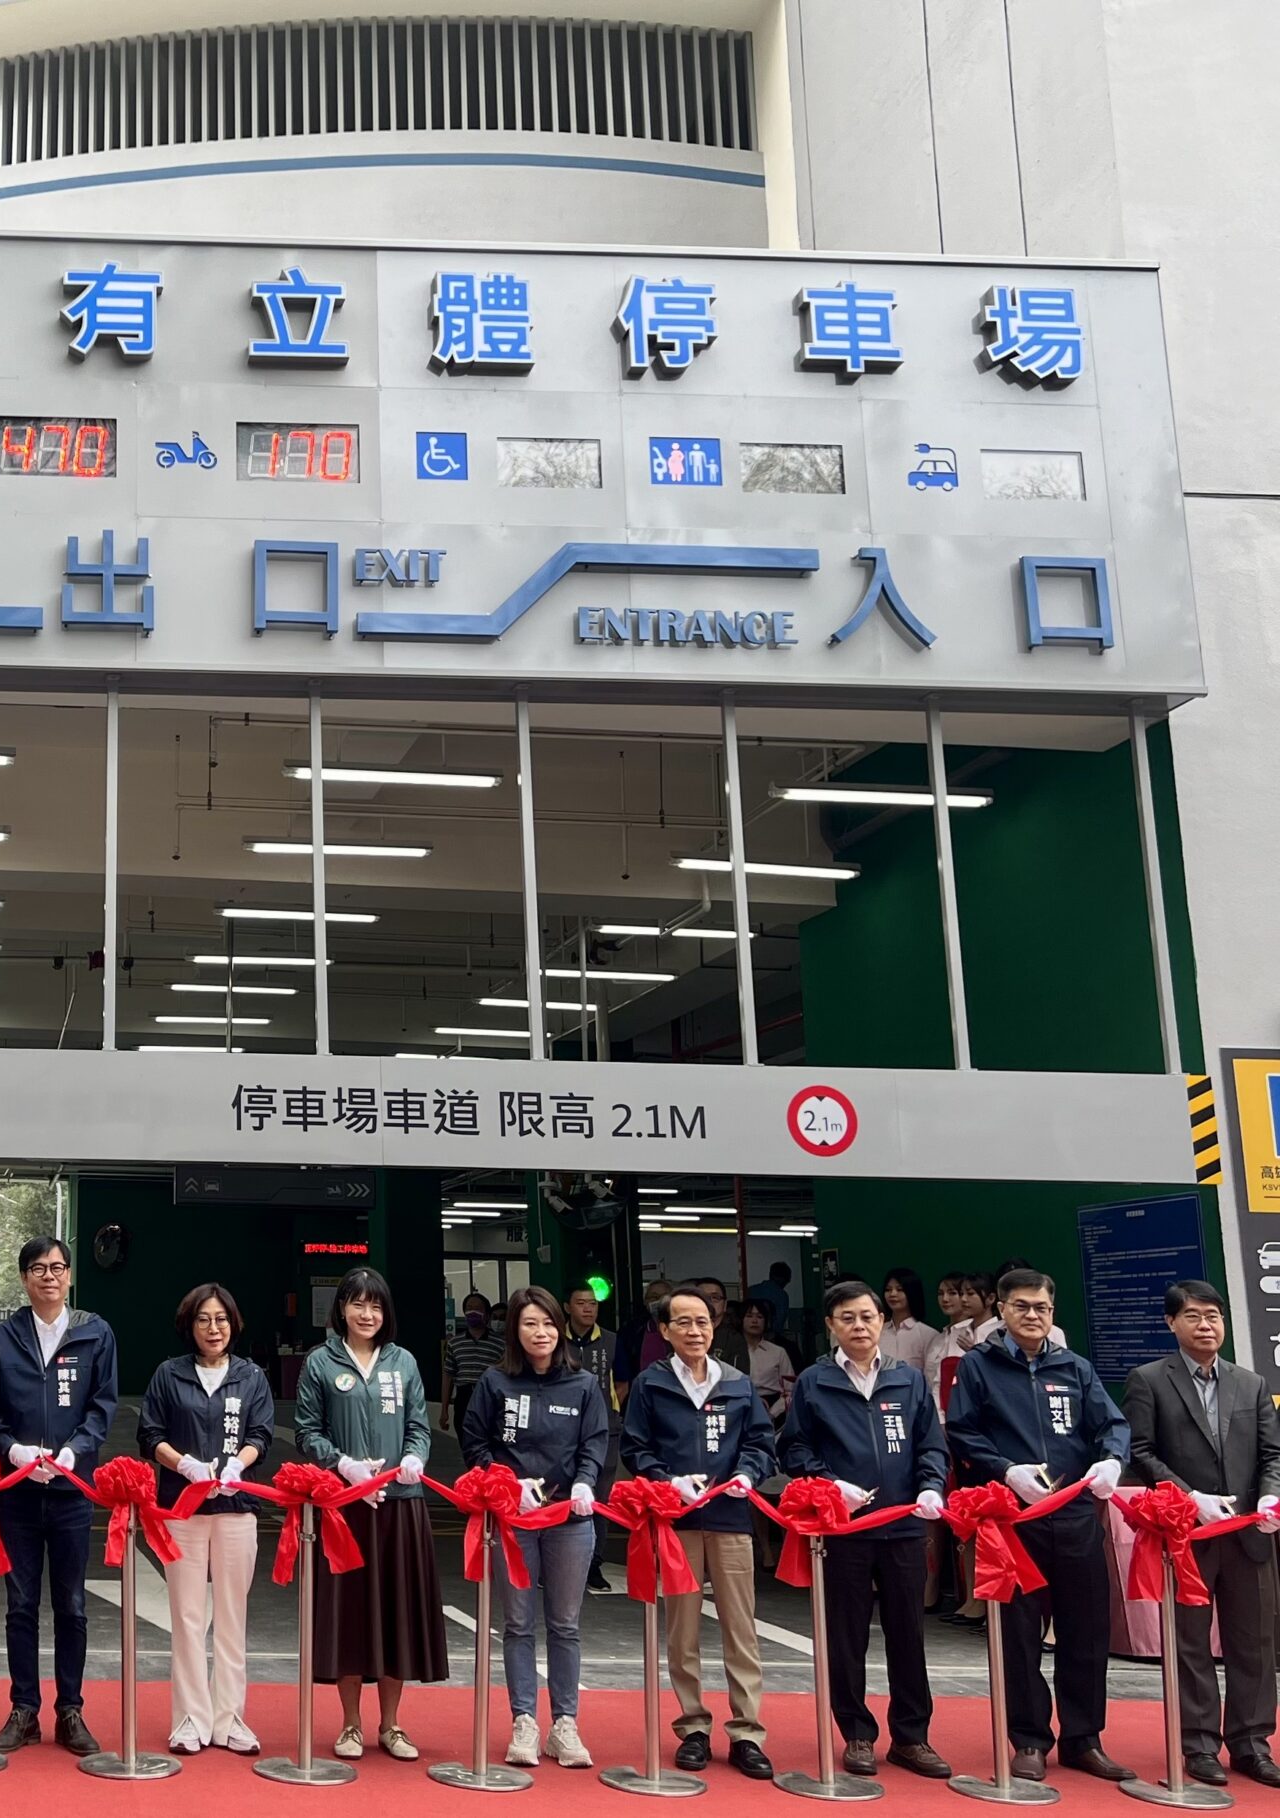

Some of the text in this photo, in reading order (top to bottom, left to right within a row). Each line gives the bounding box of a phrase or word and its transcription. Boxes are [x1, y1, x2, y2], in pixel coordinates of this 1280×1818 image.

[2, 424, 110, 477] 470
[270, 430, 353, 481] 170
[354, 548, 447, 585] EXIT
[576, 605, 799, 648] ENTRANCE
[230, 1083, 708, 1141] 停車場車道 限高 2.1M
[803, 1110, 843, 1132] 2.1m
